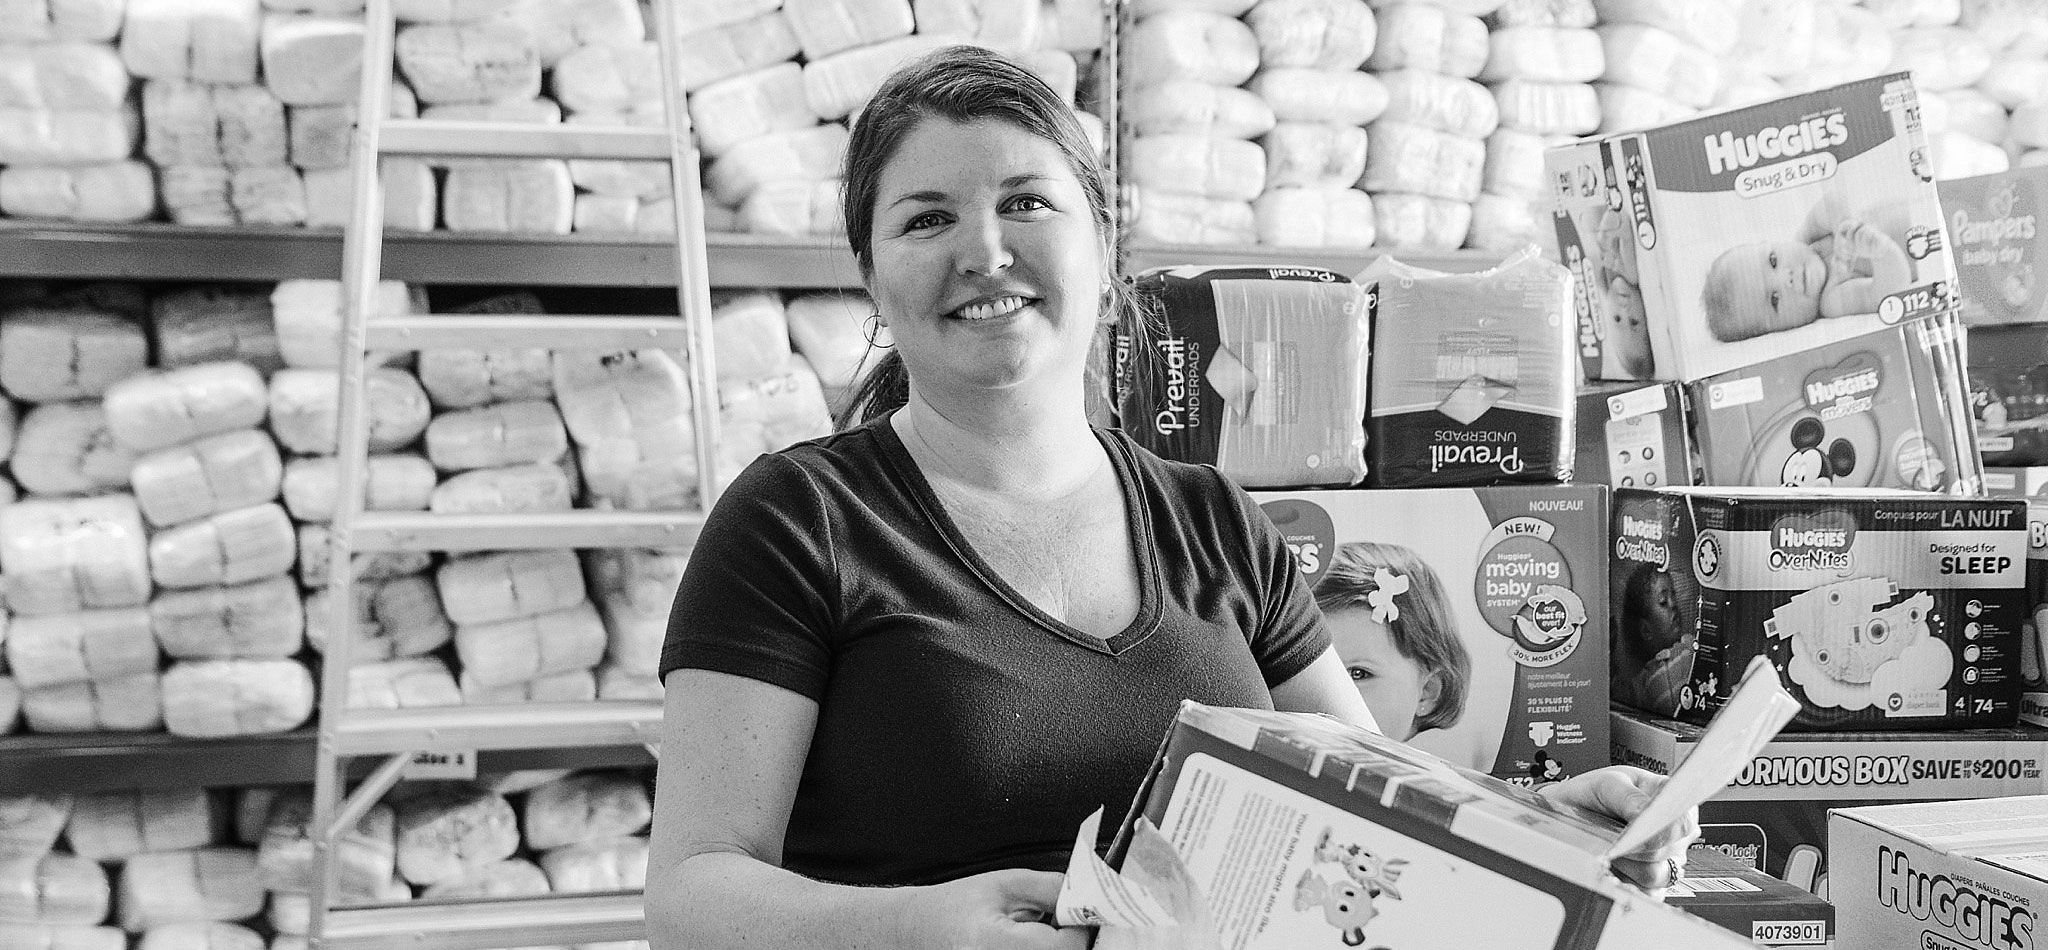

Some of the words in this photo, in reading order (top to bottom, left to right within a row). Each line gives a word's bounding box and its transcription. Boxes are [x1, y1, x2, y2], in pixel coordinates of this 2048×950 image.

[1703, 112, 1849, 176] HUGGIES
[1743, 171, 1783, 192] Snug
[1785, 166, 1796, 181] &
[1799, 160, 1828, 179] Dry
[1951, 209, 2037, 248] Pampers
[1268, 268, 1336, 283] Prevail
[1566, 244, 1600, 358] HUGGIES
[1902, 290, 1931, 313] 112
[1155, 337, 1185, 436] Prevail
[1187, 341, 1201, 428] UNDERPADS
[1806, 371, 1879, 406] HUGGIES
[1433, 429, 1518, 443] UNDERPADS
[1428, 444, 1524, 475] Prevail
[1529, 499, 1584, 512] NOUVEAU!
[1622, 514, 1663, 541] HUGGIES
[1915, 510, 1939, 523] pour
[1940, 509, 1966, 528] LA
[1967, 508, 2014, 528] NUIT
[1504, 522, 1541, 536] NEW!
[1779, 527, 1847, 548] HUGGIES
[1929, 542, 1980, 556] Designed
[1980, 541, 1997, 554] for
[1485, 558, 1561, 579] moving
[1767, 549, 1850, 570] OverNites
[1939, 556, 2012, 575] SLEEP
[1486, 578, 1532, 598] baby
[1513, 649, 1530, 662] 30%
[1531, 653, 1555, 663] MORE
[1555, 643, 1574, 658] FLEX
[1544, 696, 1562, 705] PLUS
[1563, 696, 1573, 704] DE
[1683, 687, 1690, 700] 4
[1694, 694, 1706, 712] 74
[1954, 696, 1966, 709] 4
[1974, 698, 1995, 714] 74
[1728, 756, 1850, 786] ORMOUS
[1853, 755, 1910, 785] BOX
[1911, 759, 1962, 780] SAVE
[1963, 759, 1973, 769] UP
[1963, 769, 1972, 779] TO
[1973, 759, 2023, 780] $200
[2023, 759, 2037, 769] PER
[1295, 813, 1309, 836] Your
[1283, 837, 1300, 862] baby
[1273, 863, 1289, 893] might
[1877, 844, 2035, 950] HUGGIES
[1950, 872, 1974, 888] DIAPERS
[1975, 881, 2001, 897] PAÑALES
[2002, 890, 2031, 907] COUCHES
[1264, 894, 1278, 914] also
